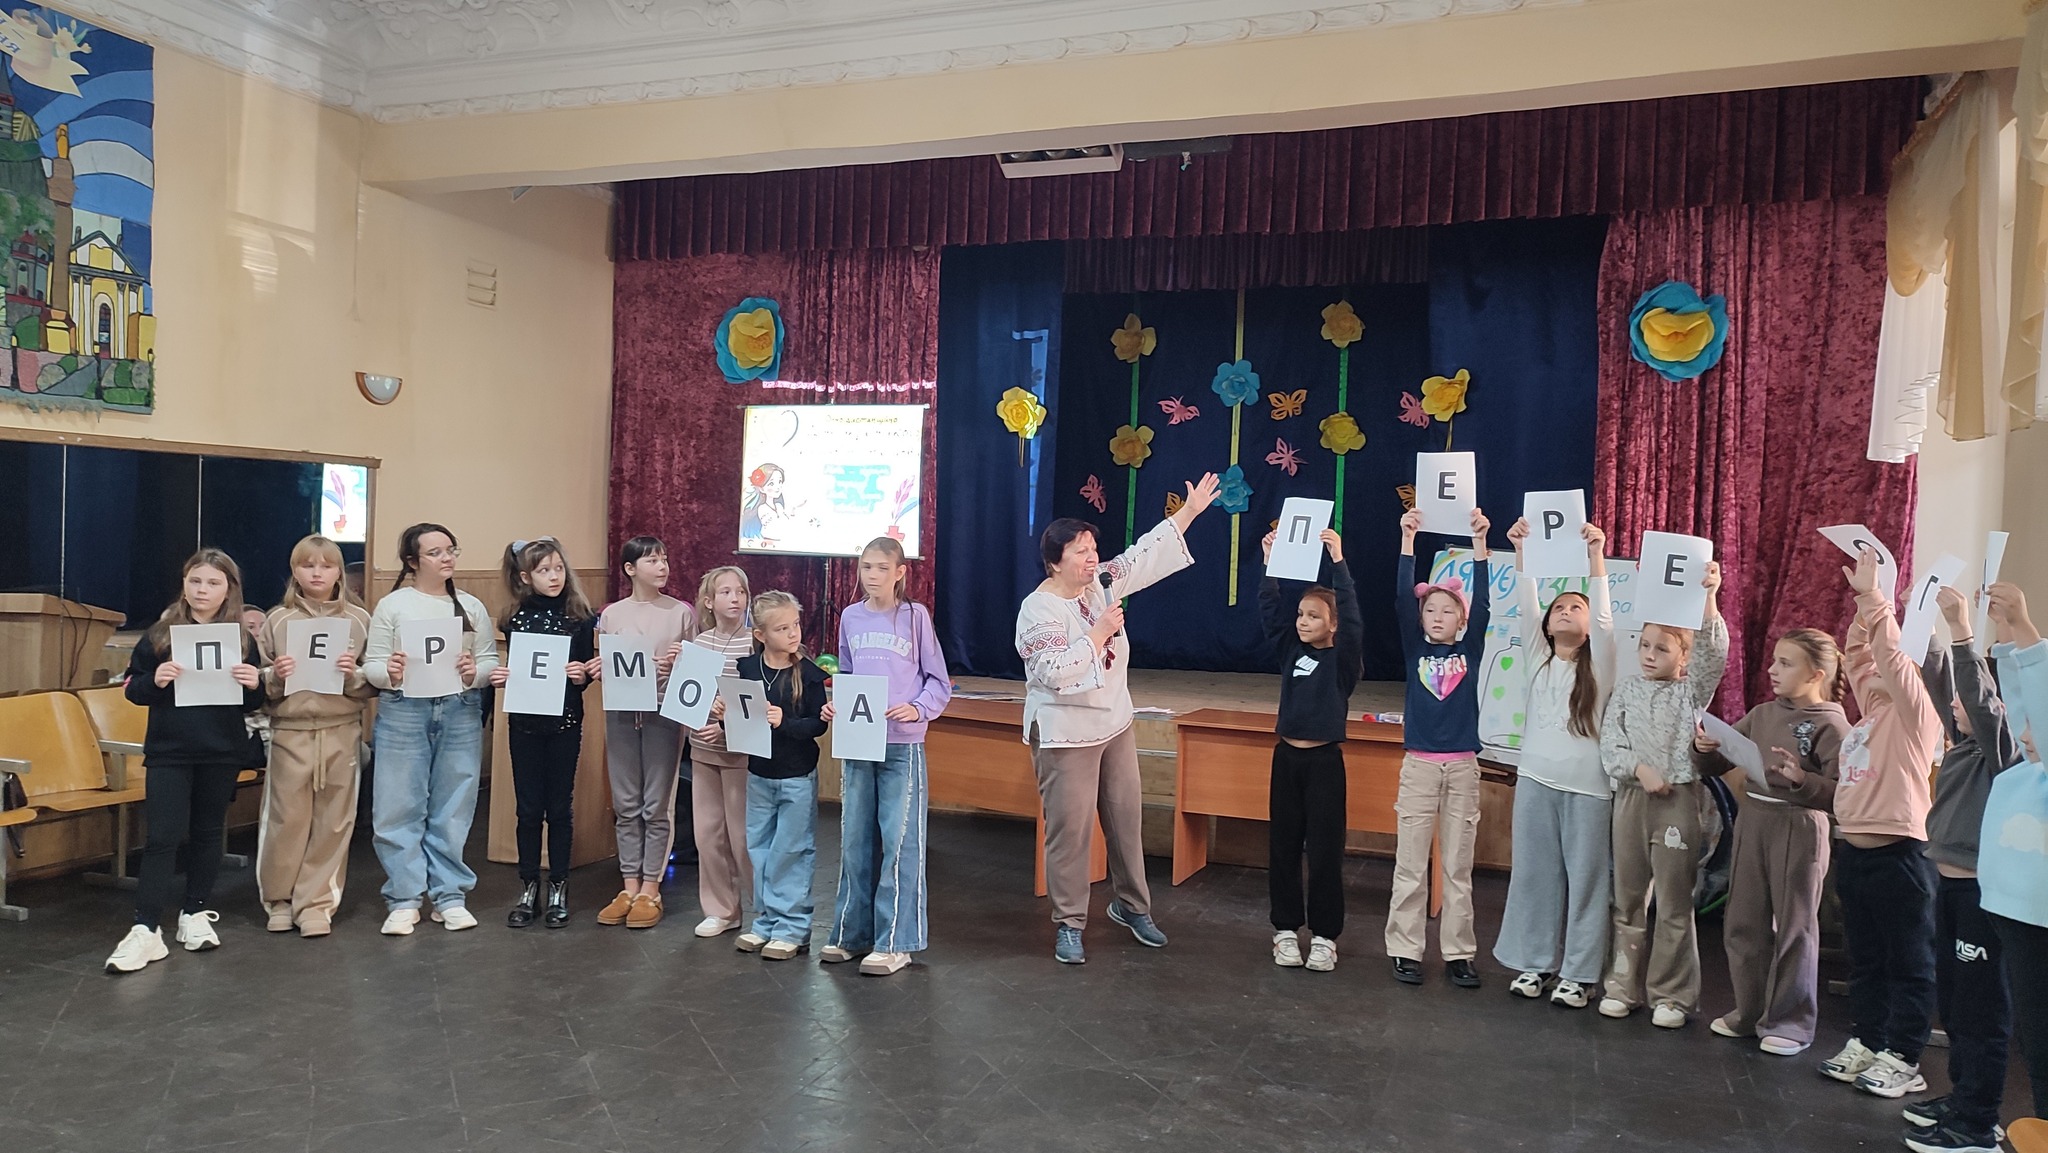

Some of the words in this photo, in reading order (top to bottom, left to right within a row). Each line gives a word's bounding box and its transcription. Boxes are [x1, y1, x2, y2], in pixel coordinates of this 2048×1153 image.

[1439, 472, 1455, 499] Е
[1288, 516, 1311, 544] П
[1543, 511, 1564, 539] Р
[1664, 554, 1687, 586] Е
[196, 642, 221, 670] П
[309, 634, 328, 659] Е
[426, 637, 444, 664] Р
[531, 652, 548, 679] Е
[613, 652, 645, 677] М
[679, 680, 701, 707] О
[739, 694, 752, 719] Г
[850, 694, 873, 722] А
